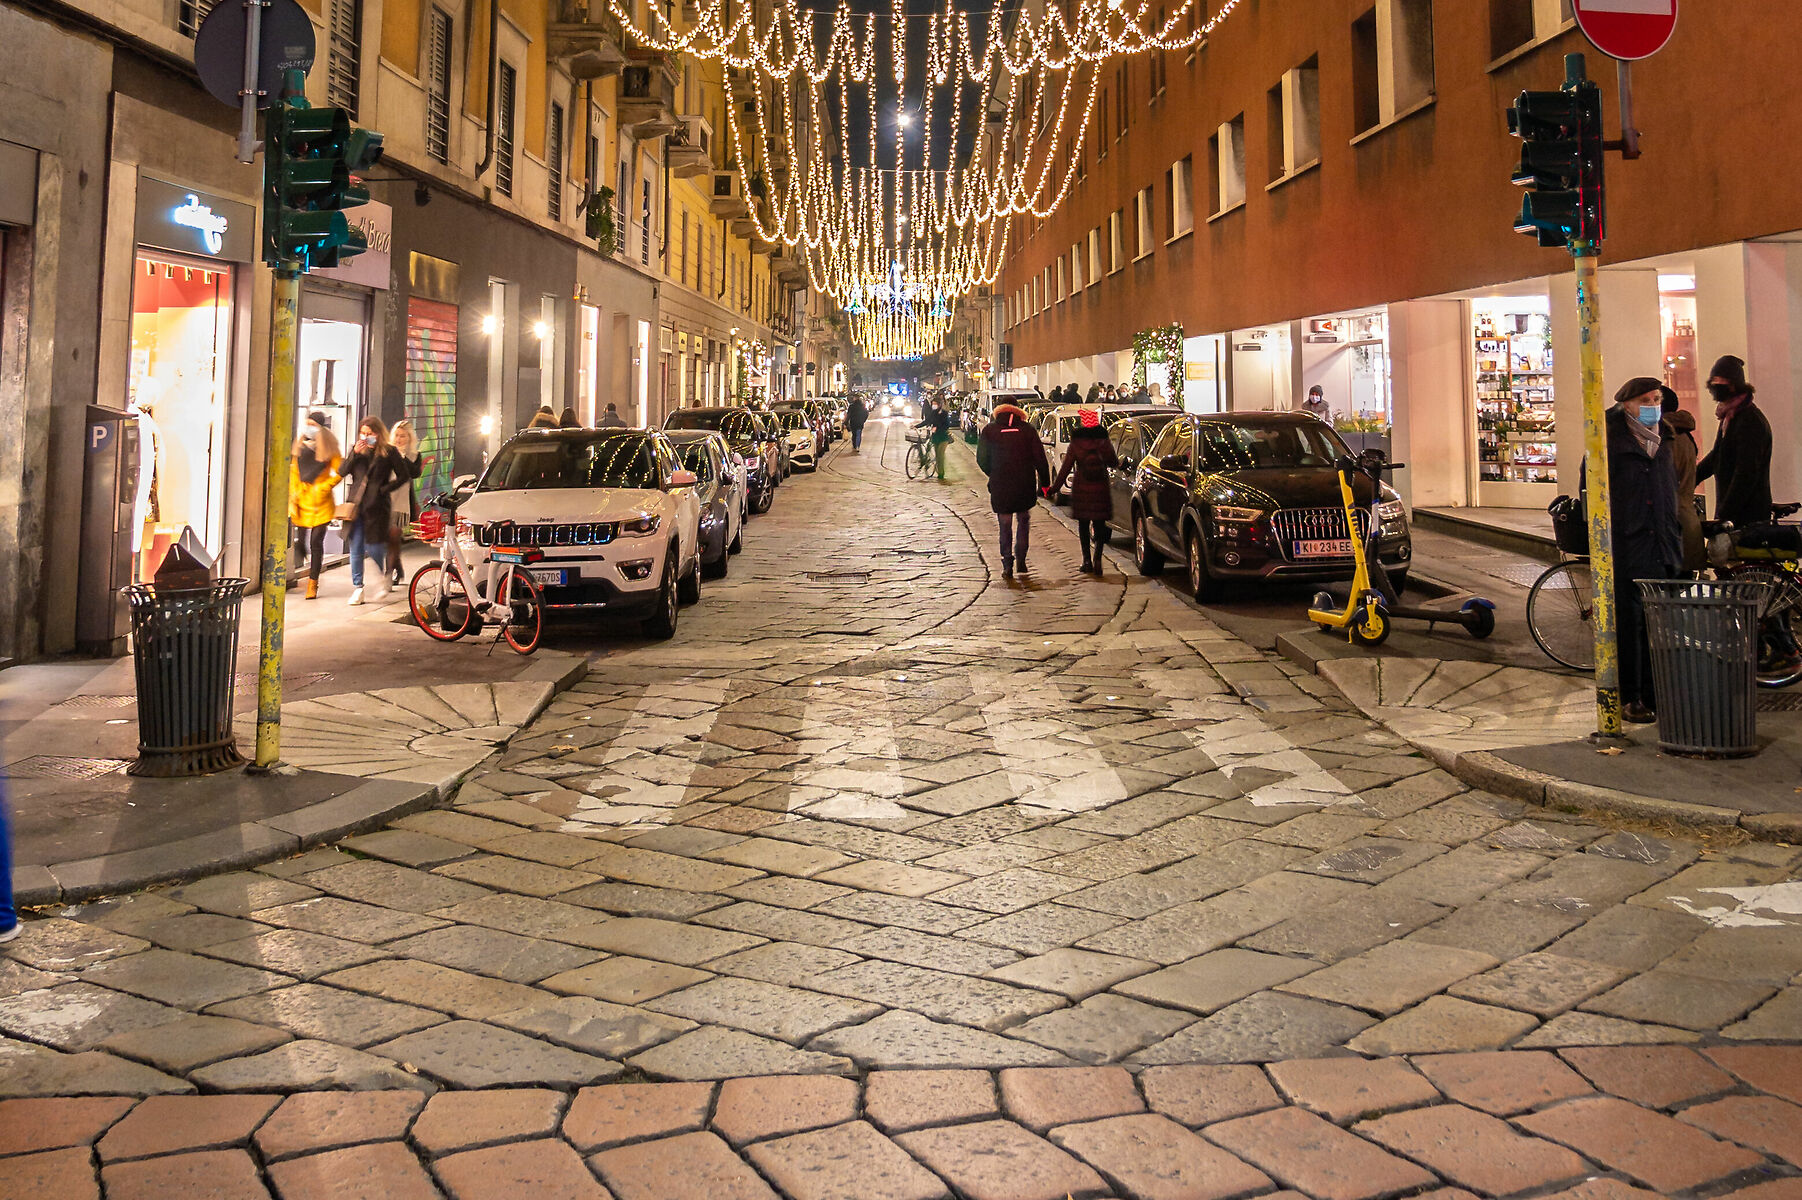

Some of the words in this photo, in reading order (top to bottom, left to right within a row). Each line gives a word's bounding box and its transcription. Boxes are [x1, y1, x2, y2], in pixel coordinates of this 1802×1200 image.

[92, 426, 107, 448] P
[1302, 543, 1312, 553] KI
[1319, 542, 1337, 552] 234
